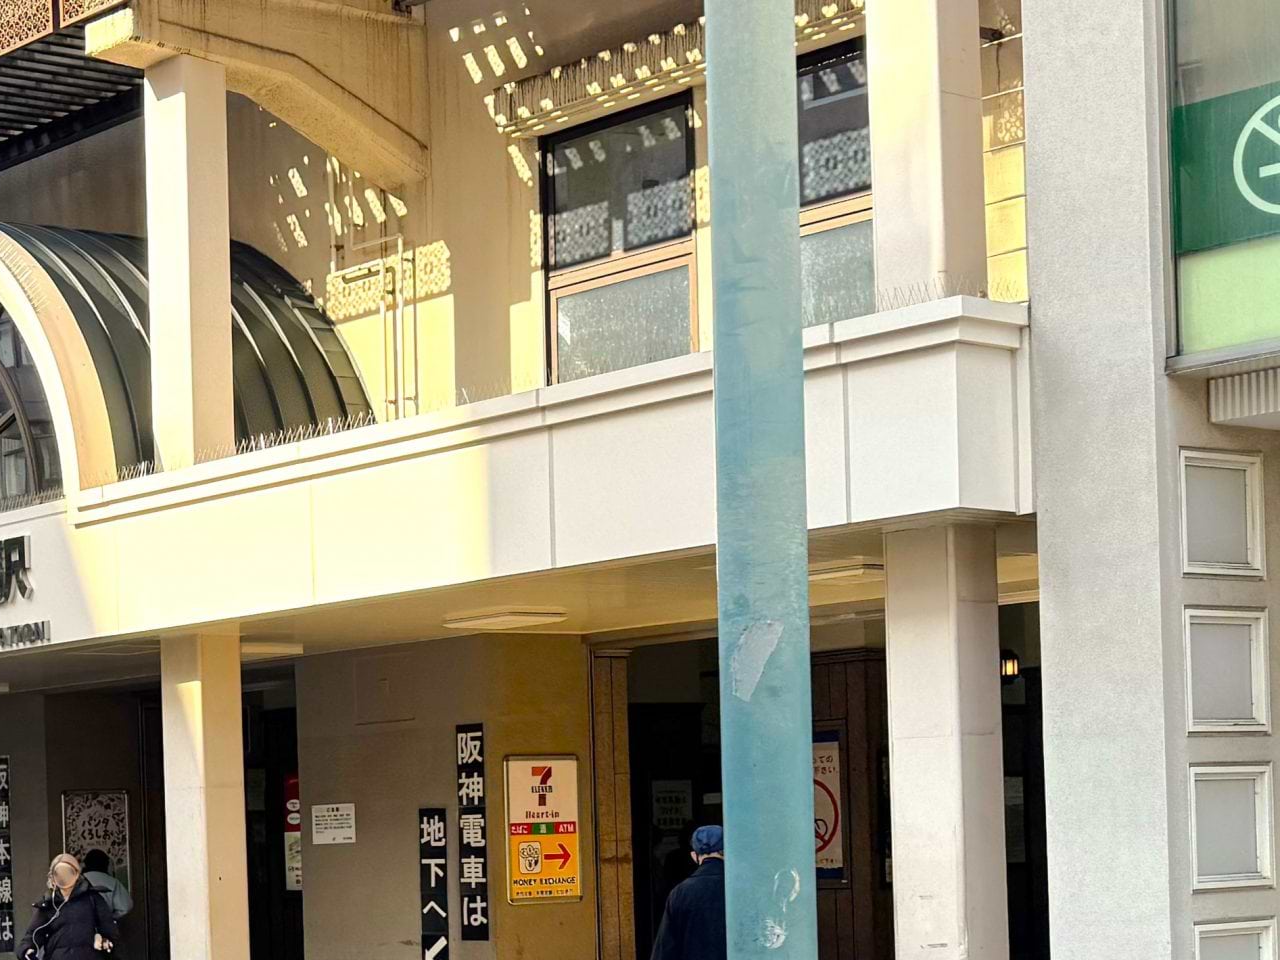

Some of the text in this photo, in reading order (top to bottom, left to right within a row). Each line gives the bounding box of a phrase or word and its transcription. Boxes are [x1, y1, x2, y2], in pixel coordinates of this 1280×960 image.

[525, 810, 560, 819] Heart-in
[456, 731, 488, 927] 阪神電車は
[558, 823, 575, 834] ATM
[420, 814, 448, 918] 地下へ
[513, 876, 576, 887] MONEY EXCHANGE
